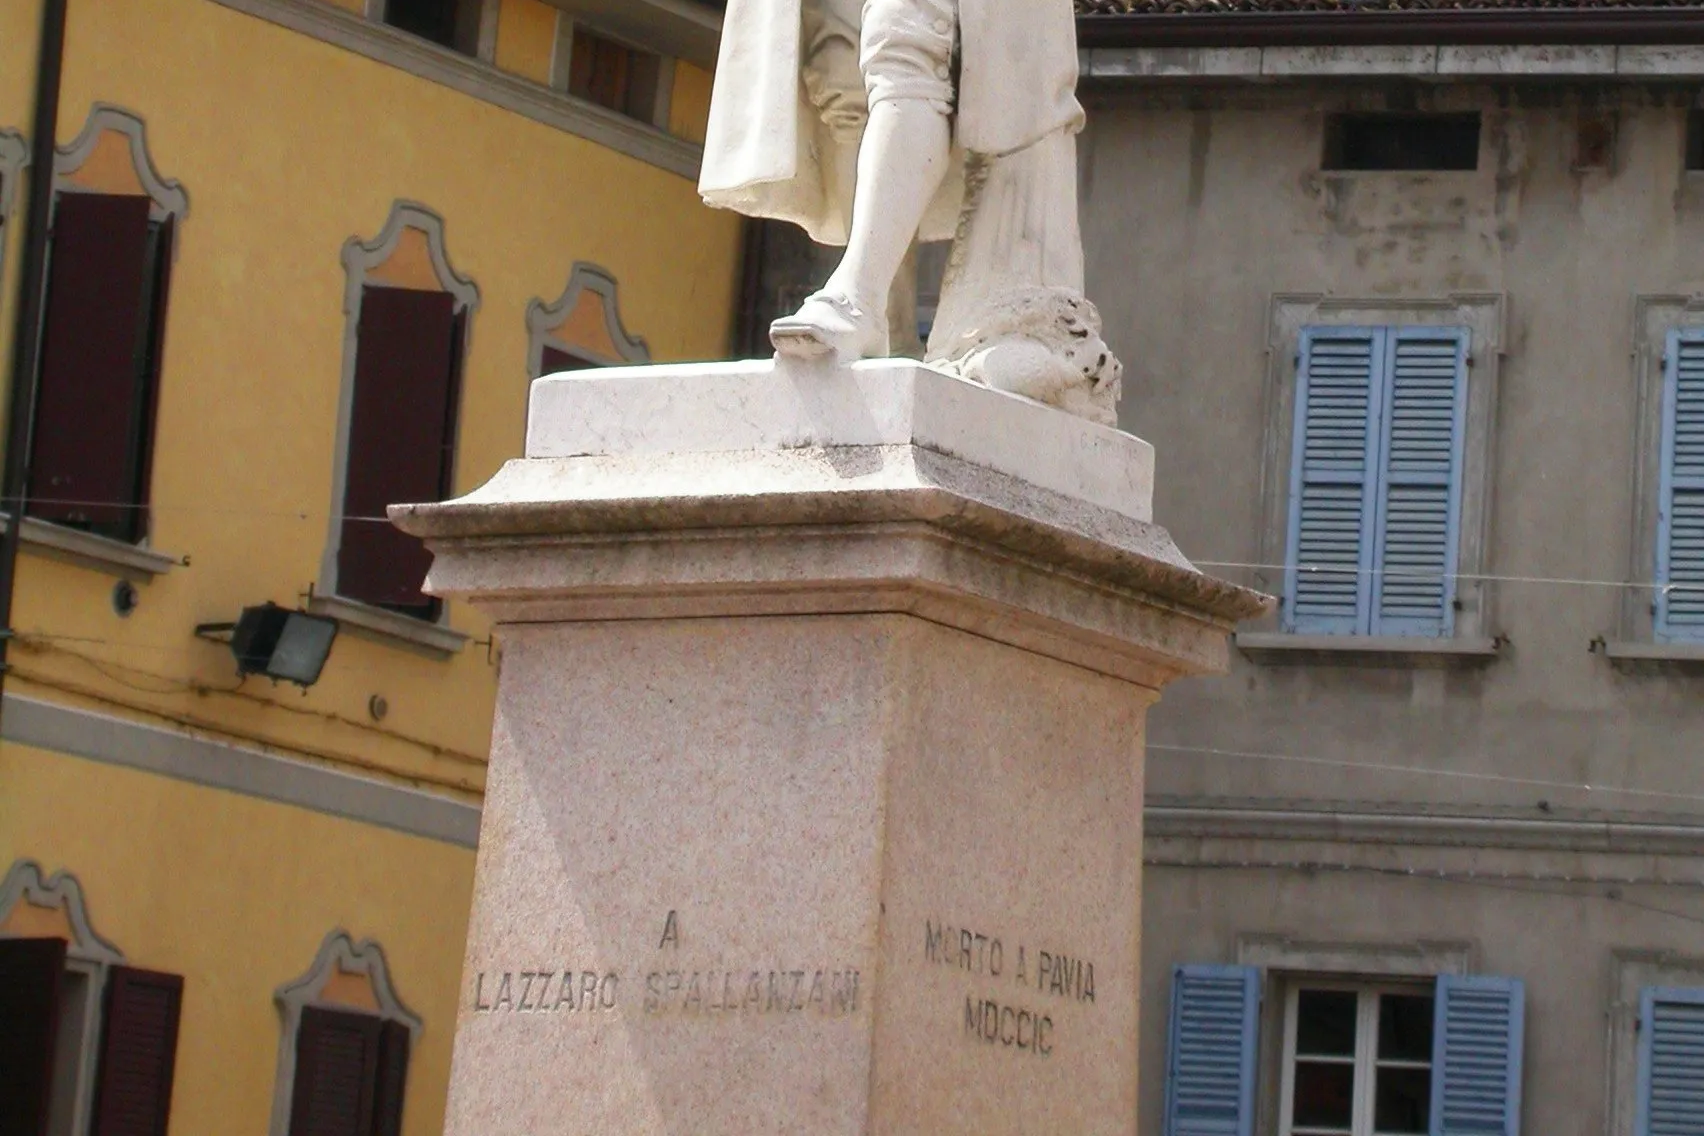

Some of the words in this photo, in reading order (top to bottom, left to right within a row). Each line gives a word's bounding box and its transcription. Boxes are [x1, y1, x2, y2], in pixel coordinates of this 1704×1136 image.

[660, 909, 680, 950] A
[924, 920, 1003, 976] MORTO
[1015, 945, 1029, 987] A
[1038, 950, 1096, 1003] PAVIA
[473, 970, 619, 1014] LAZZARO
[644, 969, 860, 1015] SPALLANZANI
[965, 997, 1053, 1054] MDCCIC
